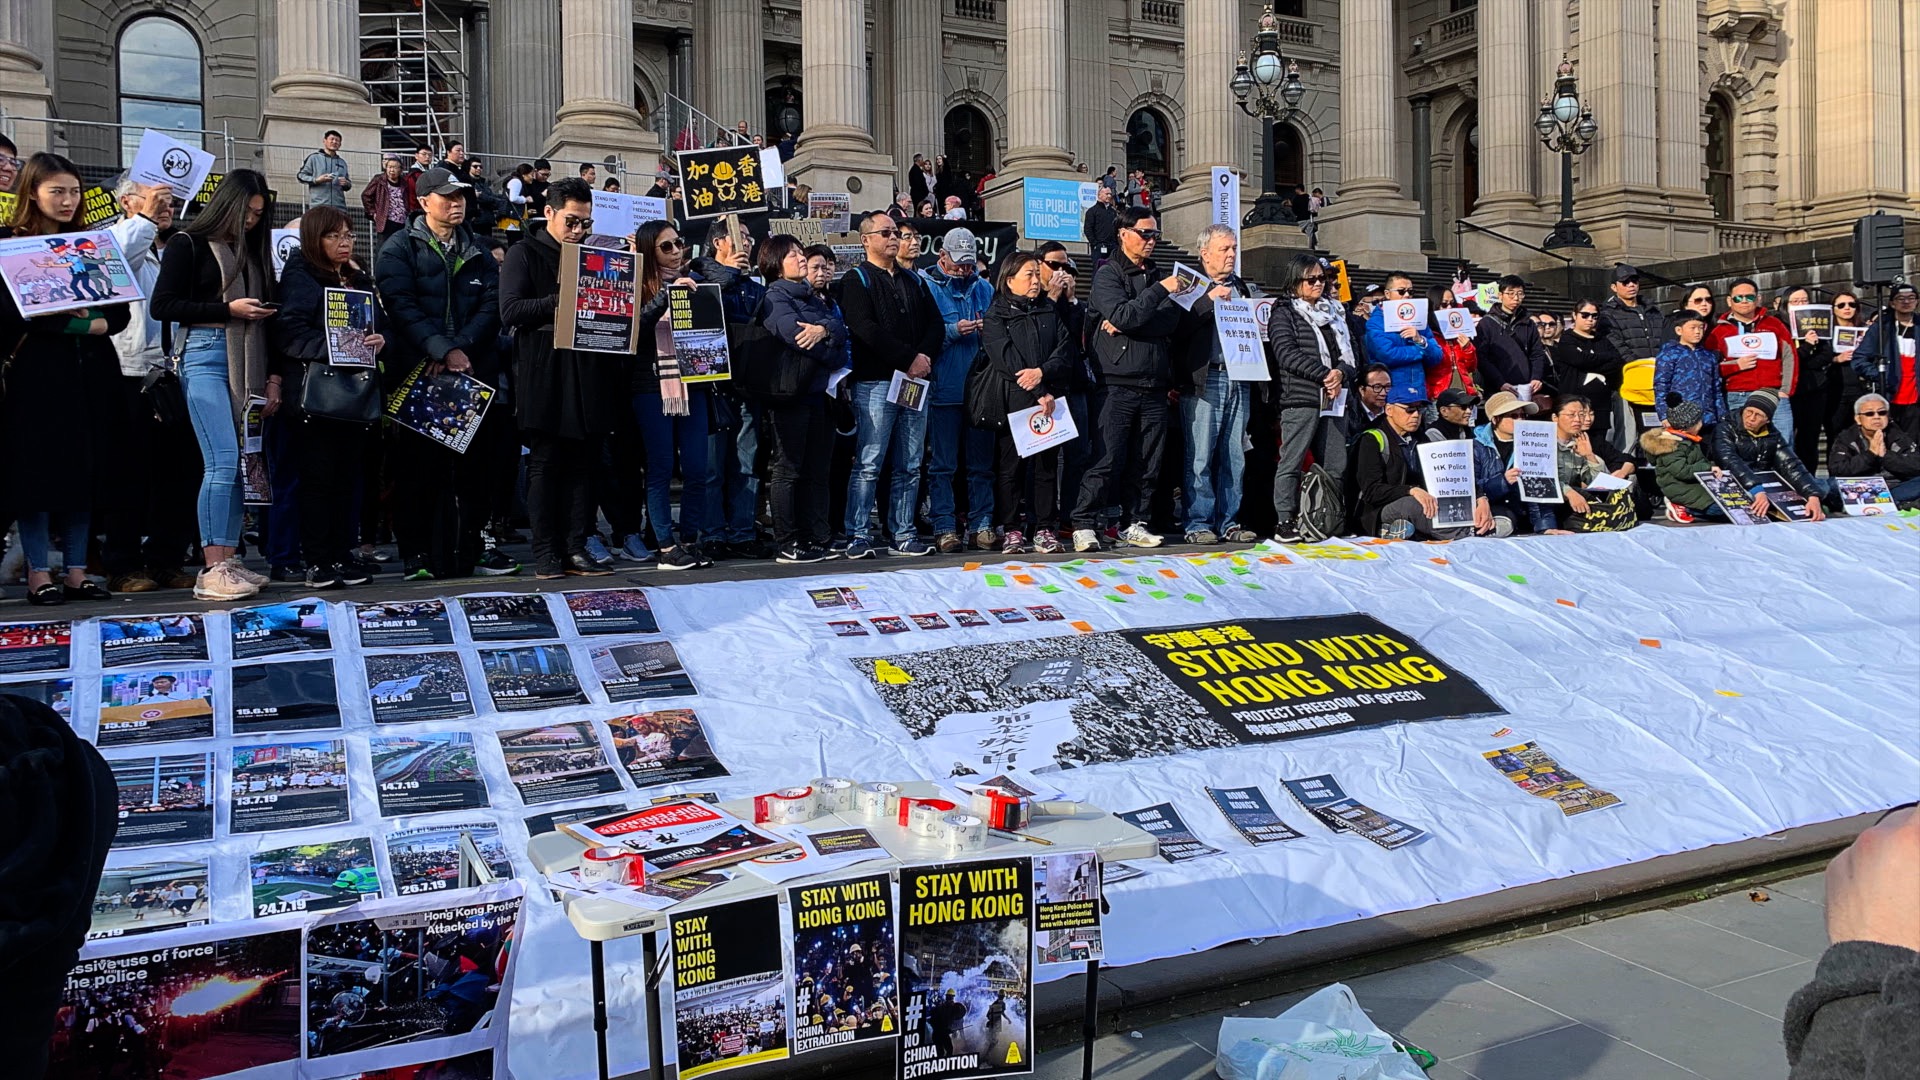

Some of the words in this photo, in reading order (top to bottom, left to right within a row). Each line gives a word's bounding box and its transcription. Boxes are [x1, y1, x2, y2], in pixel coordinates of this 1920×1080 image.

[1029, 200, 1044, 209] FREE
[1045, 198, 1078, 214] PUBLIC
[84, 204, 114, 225] HONG
[1029, 212, 1060, 228] TOURS
[770, 221, 797, 236] POLICE
[800, 221, 822, 234] TRIAD
[328, 292, 346, 301] STAY
[671, 290, 688, 299] STAY
[328, 301, 348, 310] WITH
[672, 300, 690, 310] WITH
[1220, 304, 1249, 312] FREEDOM
[328, 310, 349, 318] HONG
[672, 310, 692, 320] HONG
[328, 319, 348, 327] KONG
[673, 320, 693, 329] KONG
[387, 386, 411, 415] HONG
[406, 361, 427, 386] KONG
[444, 434, 454, 445] NO
[450, 430, 466, 448] CHINA
[457, 414, 481, 451] EXTRADITION
[1521, 430, 1549, 438] Condemn
[1430, 451, 1467, 460] Condemn
[1448, 463, 1467, 471] Police
[1436, 476, 1461, 484] linkage
[1451, 488, 1469, 496] Triads
[362, 619, 403, 629] FEB-MAY
[405, 619, 418, 627] 19
[1142, 625, 1255, 650] 守護香港
[1167, 642, 1304, 678] STAND
[1296, 633, 1410, 663] WITH
[1197, 669, 1334, 707] HONG
[1321, 655, 1448, 691] KONG
[1231, 705, 1294, 724] PROTECT
[1293, 696, 1359, 715] FREEDOM
[1360, 694, 1377, 706] OF
[1376, 689, 1426, 705] SPEECH
[380, 781, 420, 791] 14.7.19
[1300, 779, 1325, 790] HONG
[235, 794, 278, 806] 13.7.19
[1224, 790, 1250, 800] HONG
[1304, 788, 1335, 799] KONG'S
[1228, 800, 1260, 809] KONG'S
[685, 810, 713, 820] BUT
[1135, 809, 1162, 822] HONG
[1140, 819, 1173, 832] KONG'S
[401, 880, 447, 895] 26.7.19
[916, 872, 963, 899] STAY
[967, 867, 1018, 893] WITH
[801, 886, 837, 908] STAY
[841, 880, 880, 902] WITH
[258, 899, 307, 917] 24.7.19
[424, 909, 453, 922] Hong
[456, 905, 485, 918] Kong
[799, 907, 842, 929] HONG
[846, 900, 886, 922] KONG
[909, 901, 965, 926] HONG
[971, 892, 1024, 919] KONG
[1051, 913, 1060, 921] gas
[1066, 909, 1092, 918] residential
[1053, 904, 1067, 912] Kong
[425, 919, 479, 936] Attacked
[481, 919, 495, 930] by
[496, 915, 511, 926] the
[674, 915, 708, 937] STAY
[1063, 918, 1080, 926] elderly
[676, 932, 712, 953] WITH
[120, 955, 149, 969] use
[152, 949, 169, 963] of
[171, 945, 214, 960] force
[677, 949, 716, 971] HONG
[68, 976, 90, 990] he
[94, 969, 148, 989] police
[677, 966, 716, 988] KONG
[796, 1015, 809, 1028] NO
[796, 1024, 824, 1039] CHINA
[797, 1029, 855, 1051] EXTRADITION
[904, 1032, 920, 1049] NO
[904, 1044, 938, 1065] CHINA
[903, 1054, 978, 1080] EXTRADITION
